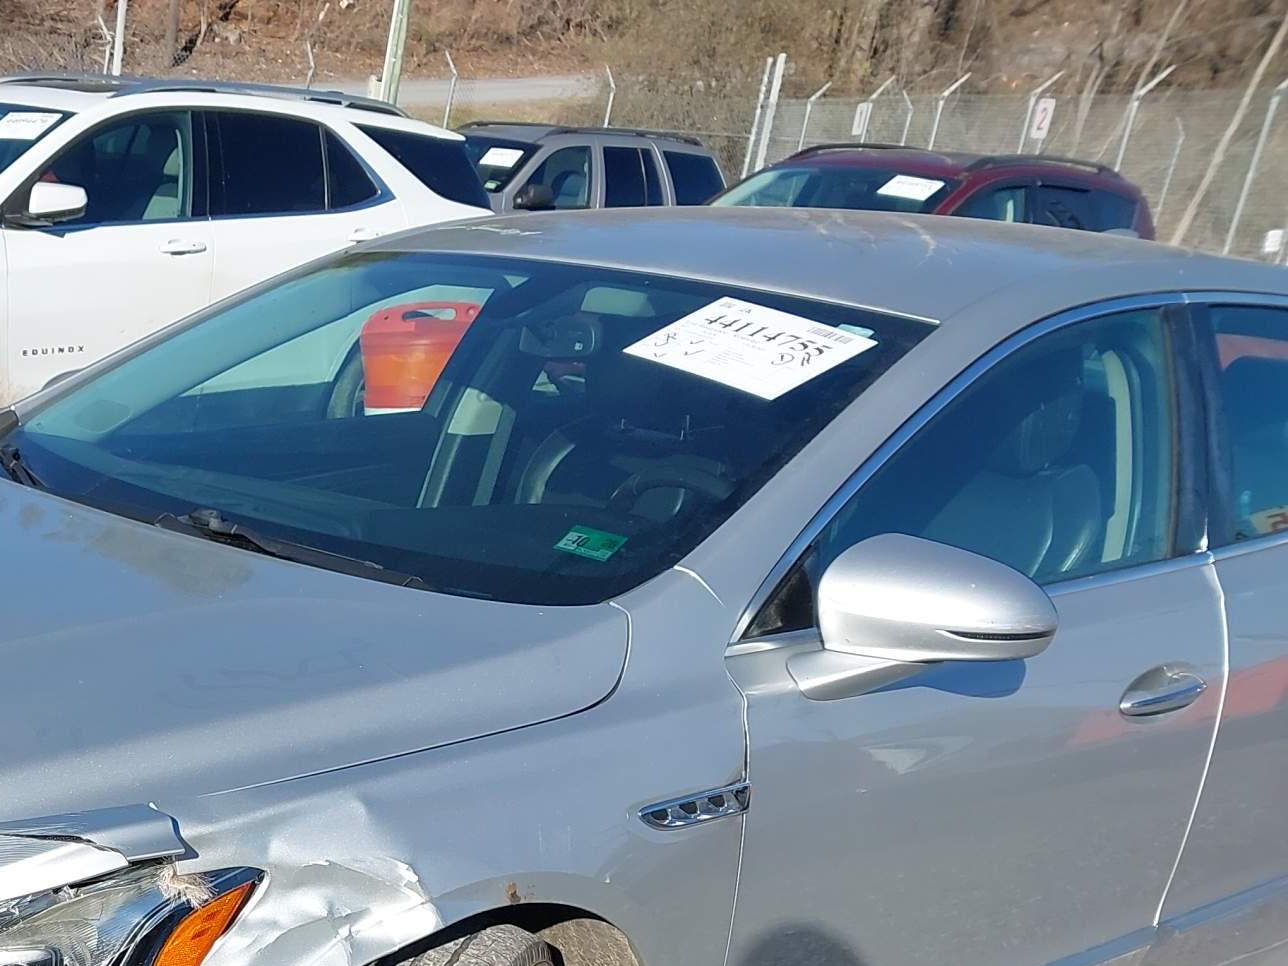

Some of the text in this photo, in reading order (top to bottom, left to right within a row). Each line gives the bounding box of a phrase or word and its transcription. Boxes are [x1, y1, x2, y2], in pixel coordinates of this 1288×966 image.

[1036, 106, 1049, 131] 2
[705, 314, 832, 356] 44114755
[22, 345, 84, 357] EQUINOX
